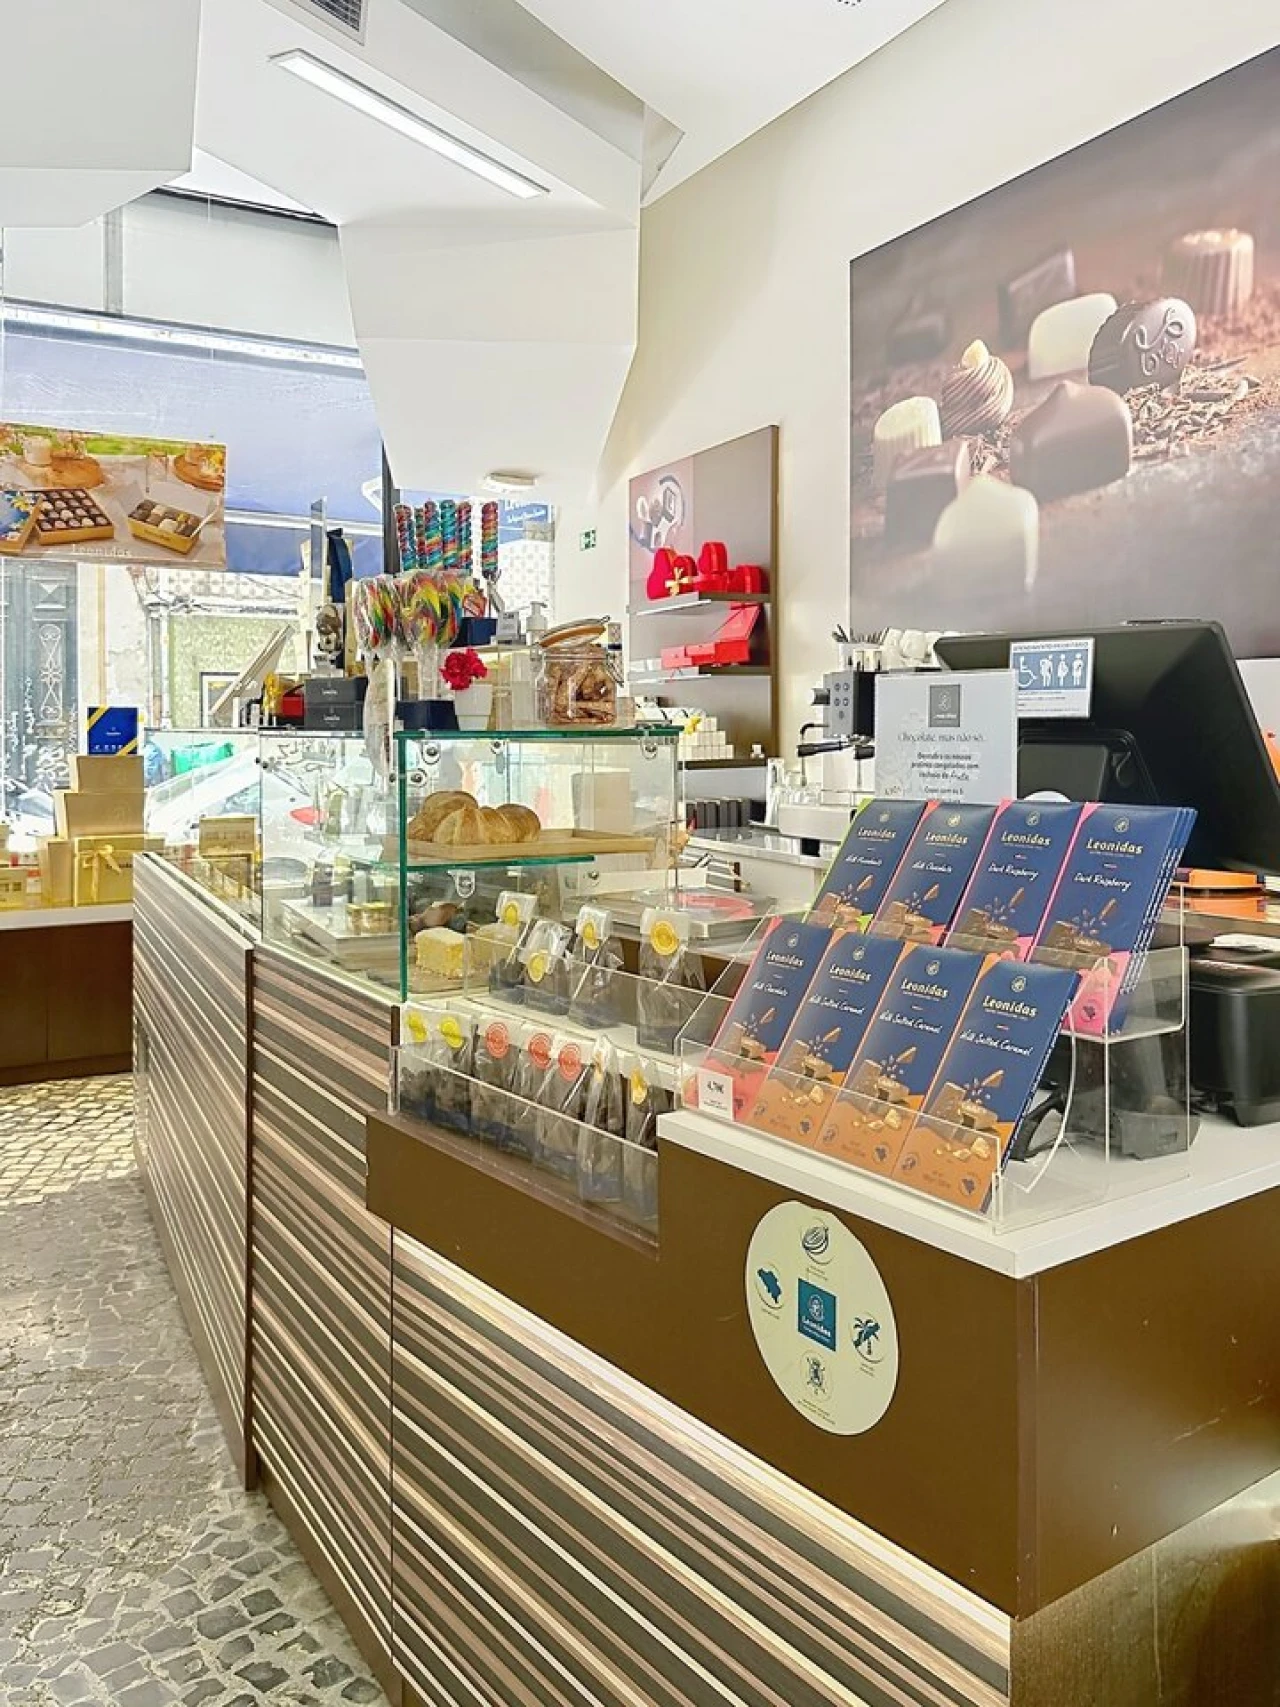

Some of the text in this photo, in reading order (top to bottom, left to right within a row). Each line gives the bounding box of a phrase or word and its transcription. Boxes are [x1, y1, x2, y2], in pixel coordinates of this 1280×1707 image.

[858, 826, 897, 839] Leonidas
[924, 831, 968, 844] Leonidas
[1001, 831, 1051, 846] Leonidas
[1086, 838, 1144, 855] Leonidas
[766, 951, 804, 967] Leonidas
[829, 963, 872, 982] Leonidas
[901, 978, 949, 999] Leonidas
[982, 995, 1038, 1017] Leonidas
[801, 1315, 831, 1338] Leonidas
